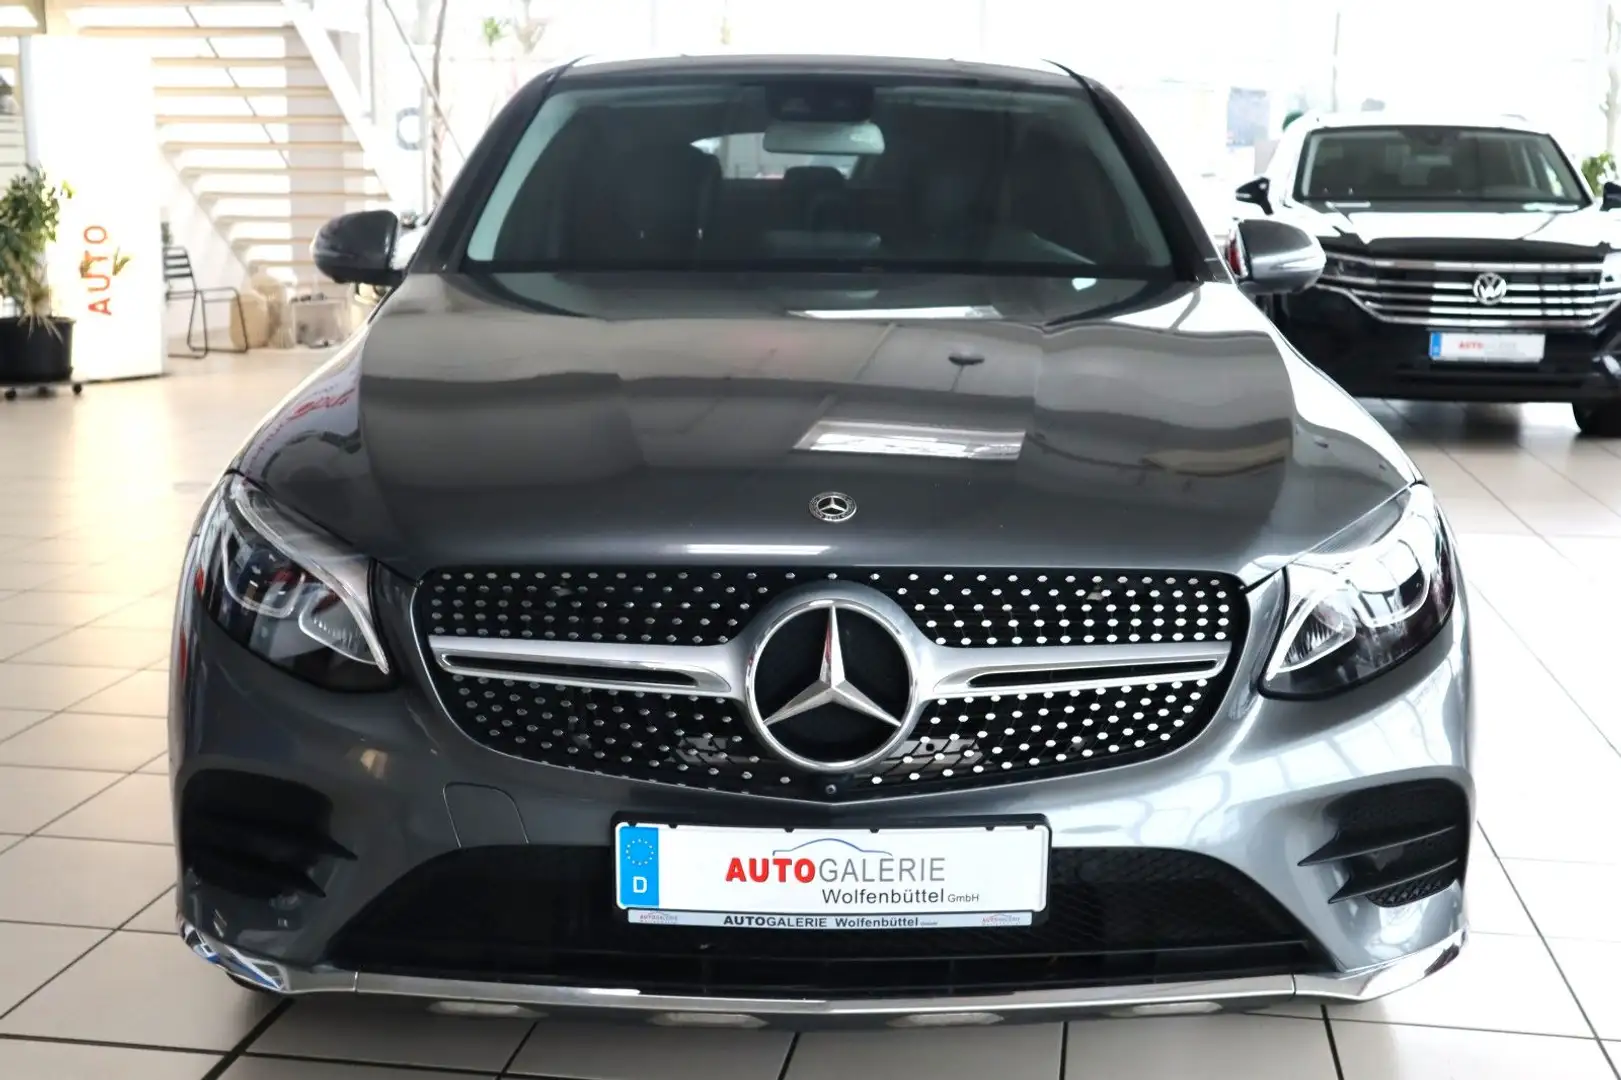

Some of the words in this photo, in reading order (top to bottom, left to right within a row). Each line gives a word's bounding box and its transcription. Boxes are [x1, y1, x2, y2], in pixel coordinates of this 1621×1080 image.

[83, 225, 112, 316] AUTO
[725, 857, 945, 883] AUTOGALERIE
[633, 876, 648, 893] D
[822, 888, 944, 904] Wolfenbüttel
[947, 893, 980, 903] GmbH
[723, 915, 828, 928] AUTOGALERIE
[835, 916, 919, 928] Wolfenbüttel
